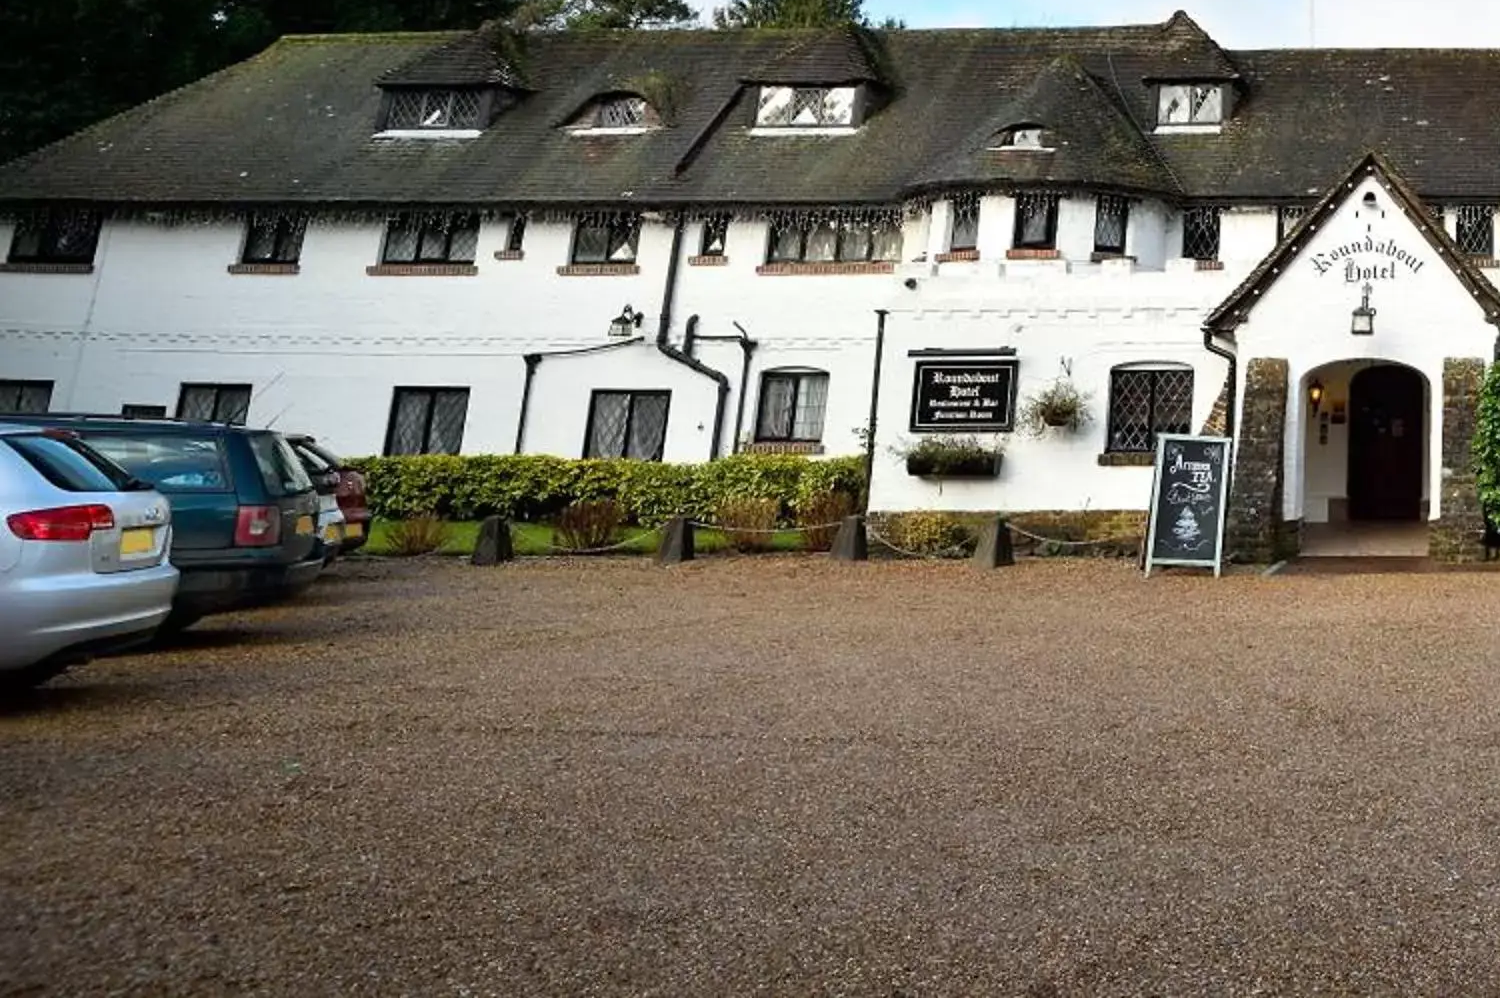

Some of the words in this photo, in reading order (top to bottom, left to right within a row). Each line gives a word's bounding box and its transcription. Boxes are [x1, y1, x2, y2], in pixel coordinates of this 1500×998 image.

[1309, 235, 1424, 276] Roundabout
[1344, 258, 1395, 282] Hotel
[931, 371, 999, 384] Roundabout
